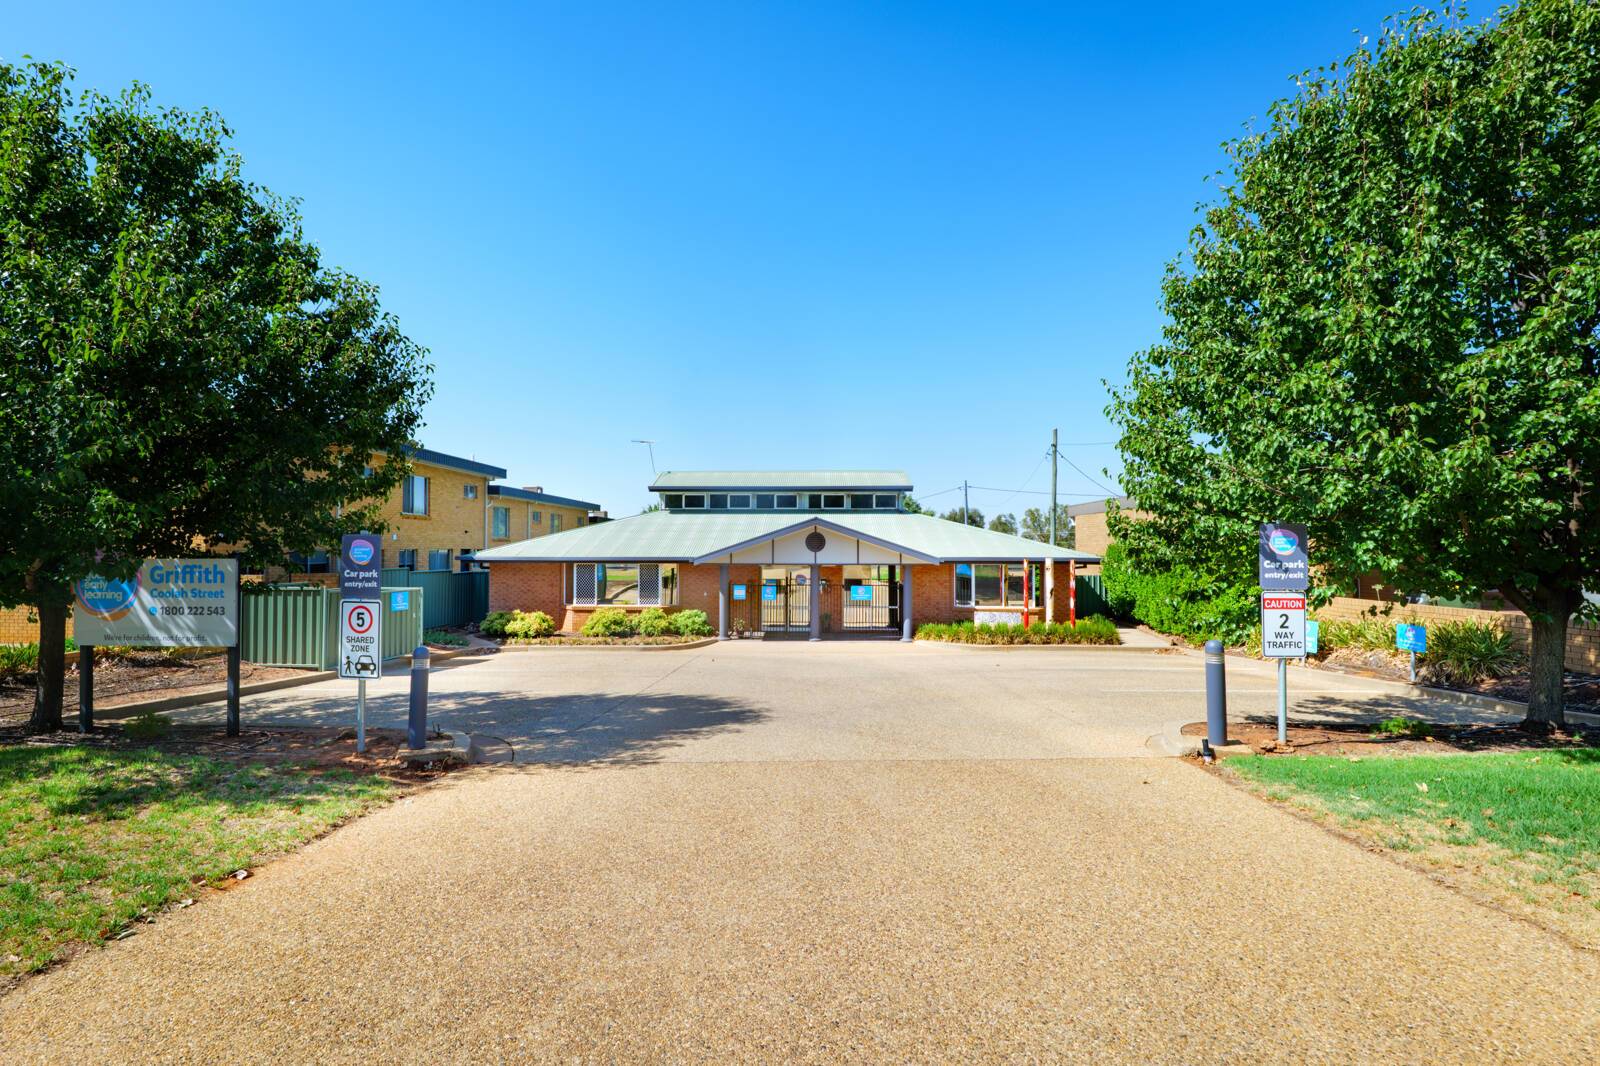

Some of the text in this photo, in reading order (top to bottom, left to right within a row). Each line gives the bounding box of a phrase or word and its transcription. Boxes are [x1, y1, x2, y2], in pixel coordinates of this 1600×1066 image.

[1263, 560, 1305, 570] Car park
[149, 564, 225, 584] Griffith
[344, 569, 378, 580] Car park
[1264, 571, 1305, 580] entry/exit
[344, 581, 378, 589] entry/exit
[85, 590, 123, 602] learning
[150, 588, 225, 599] Coolah Street
[1264, 600, 1303, 608] CAUTION
[160, 606, 225, 616] 1800 222 543
[356, 612, 365, 627] 5
[1279, 613, 1289, 629] 2
[346, 636, 375, 644] SHARED
[1274, 631, 1294, 639] WAY
[1267, 640, 1303, 649] TRAFFIC
